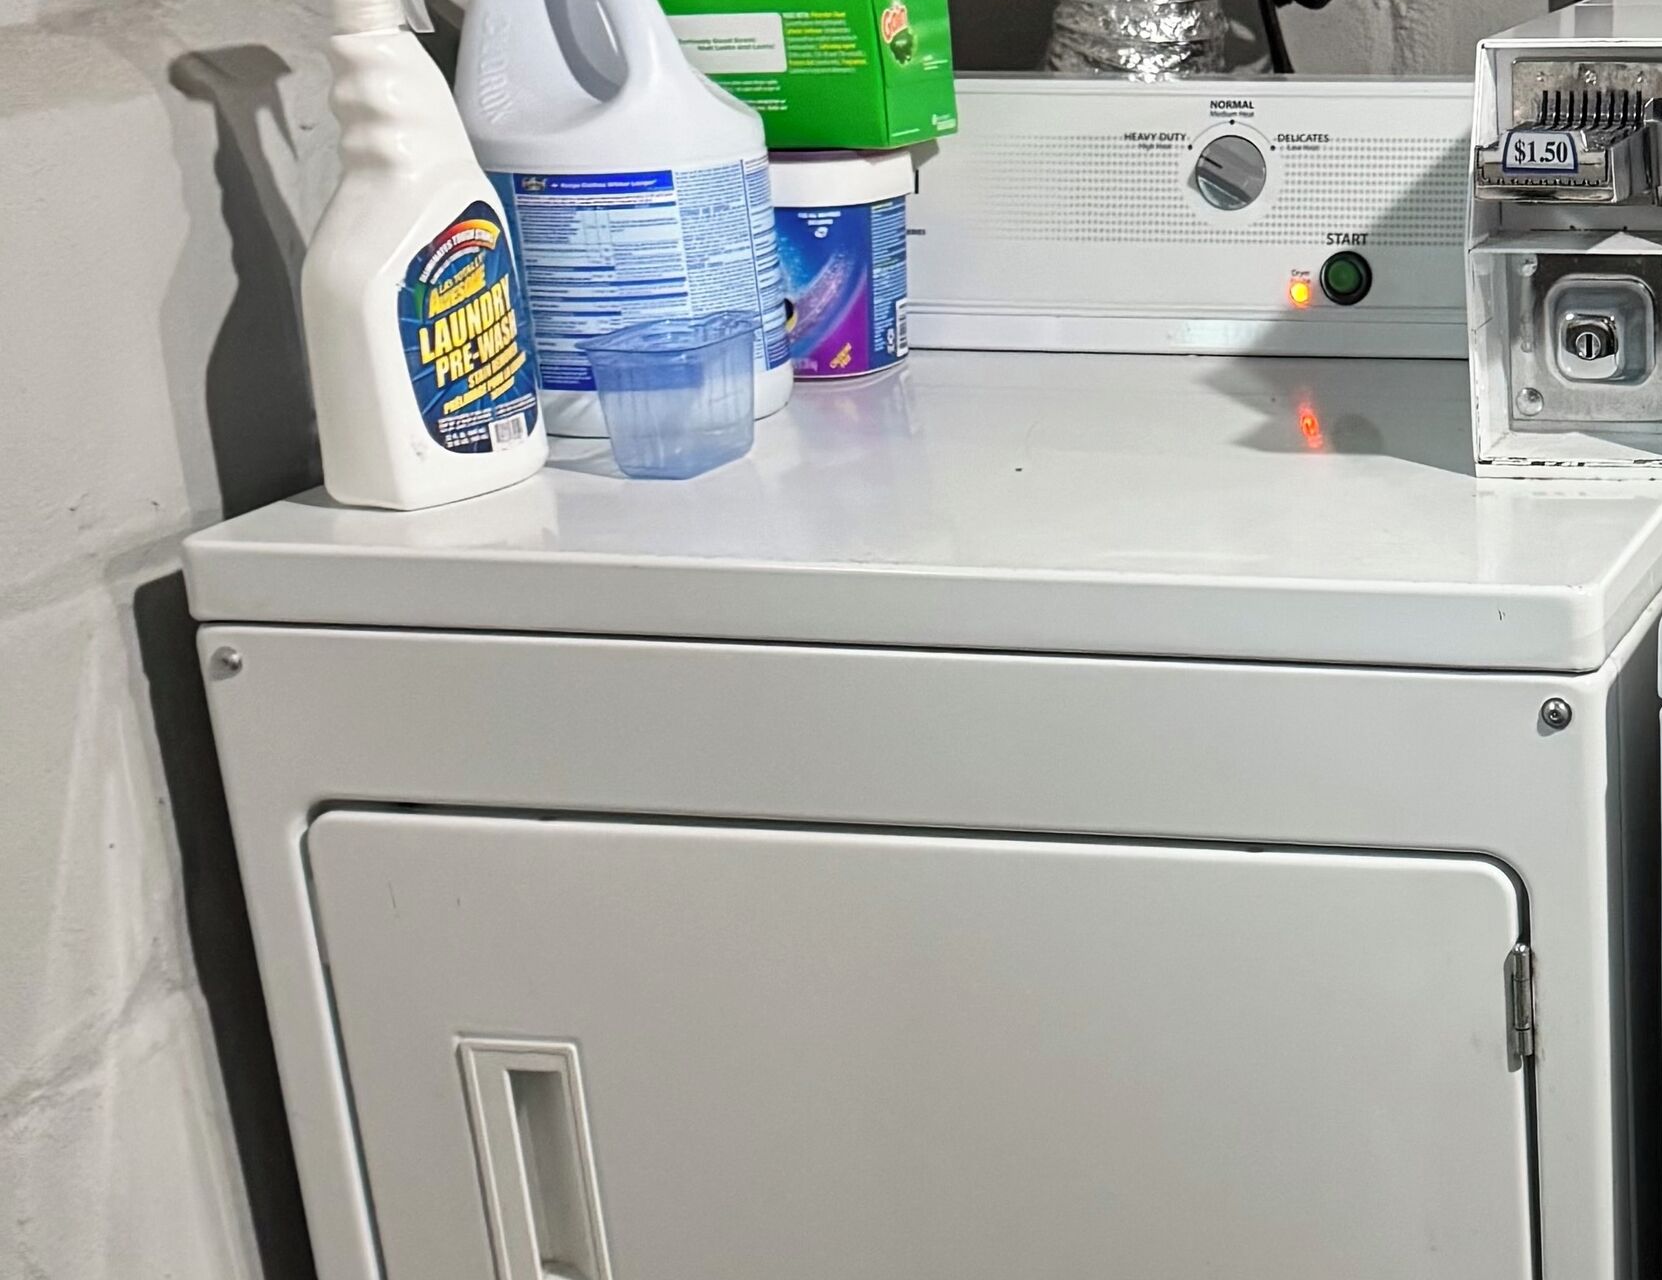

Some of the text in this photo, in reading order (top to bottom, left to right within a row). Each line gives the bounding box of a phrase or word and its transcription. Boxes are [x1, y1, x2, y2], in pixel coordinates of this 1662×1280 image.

[1209, 100, 1255, 110] NORMAL
[1123, 133, 1187, 142] HEAVY DUTY
[1276, 133, 1330, 143] DELICATES
[1514, 139, 1568, 165] $1.50
[1326, 232, 1369, 246] START
[418, 272, 512, 365] LAUNDRY
[434, 308, 518, 389] PRE-WASH
